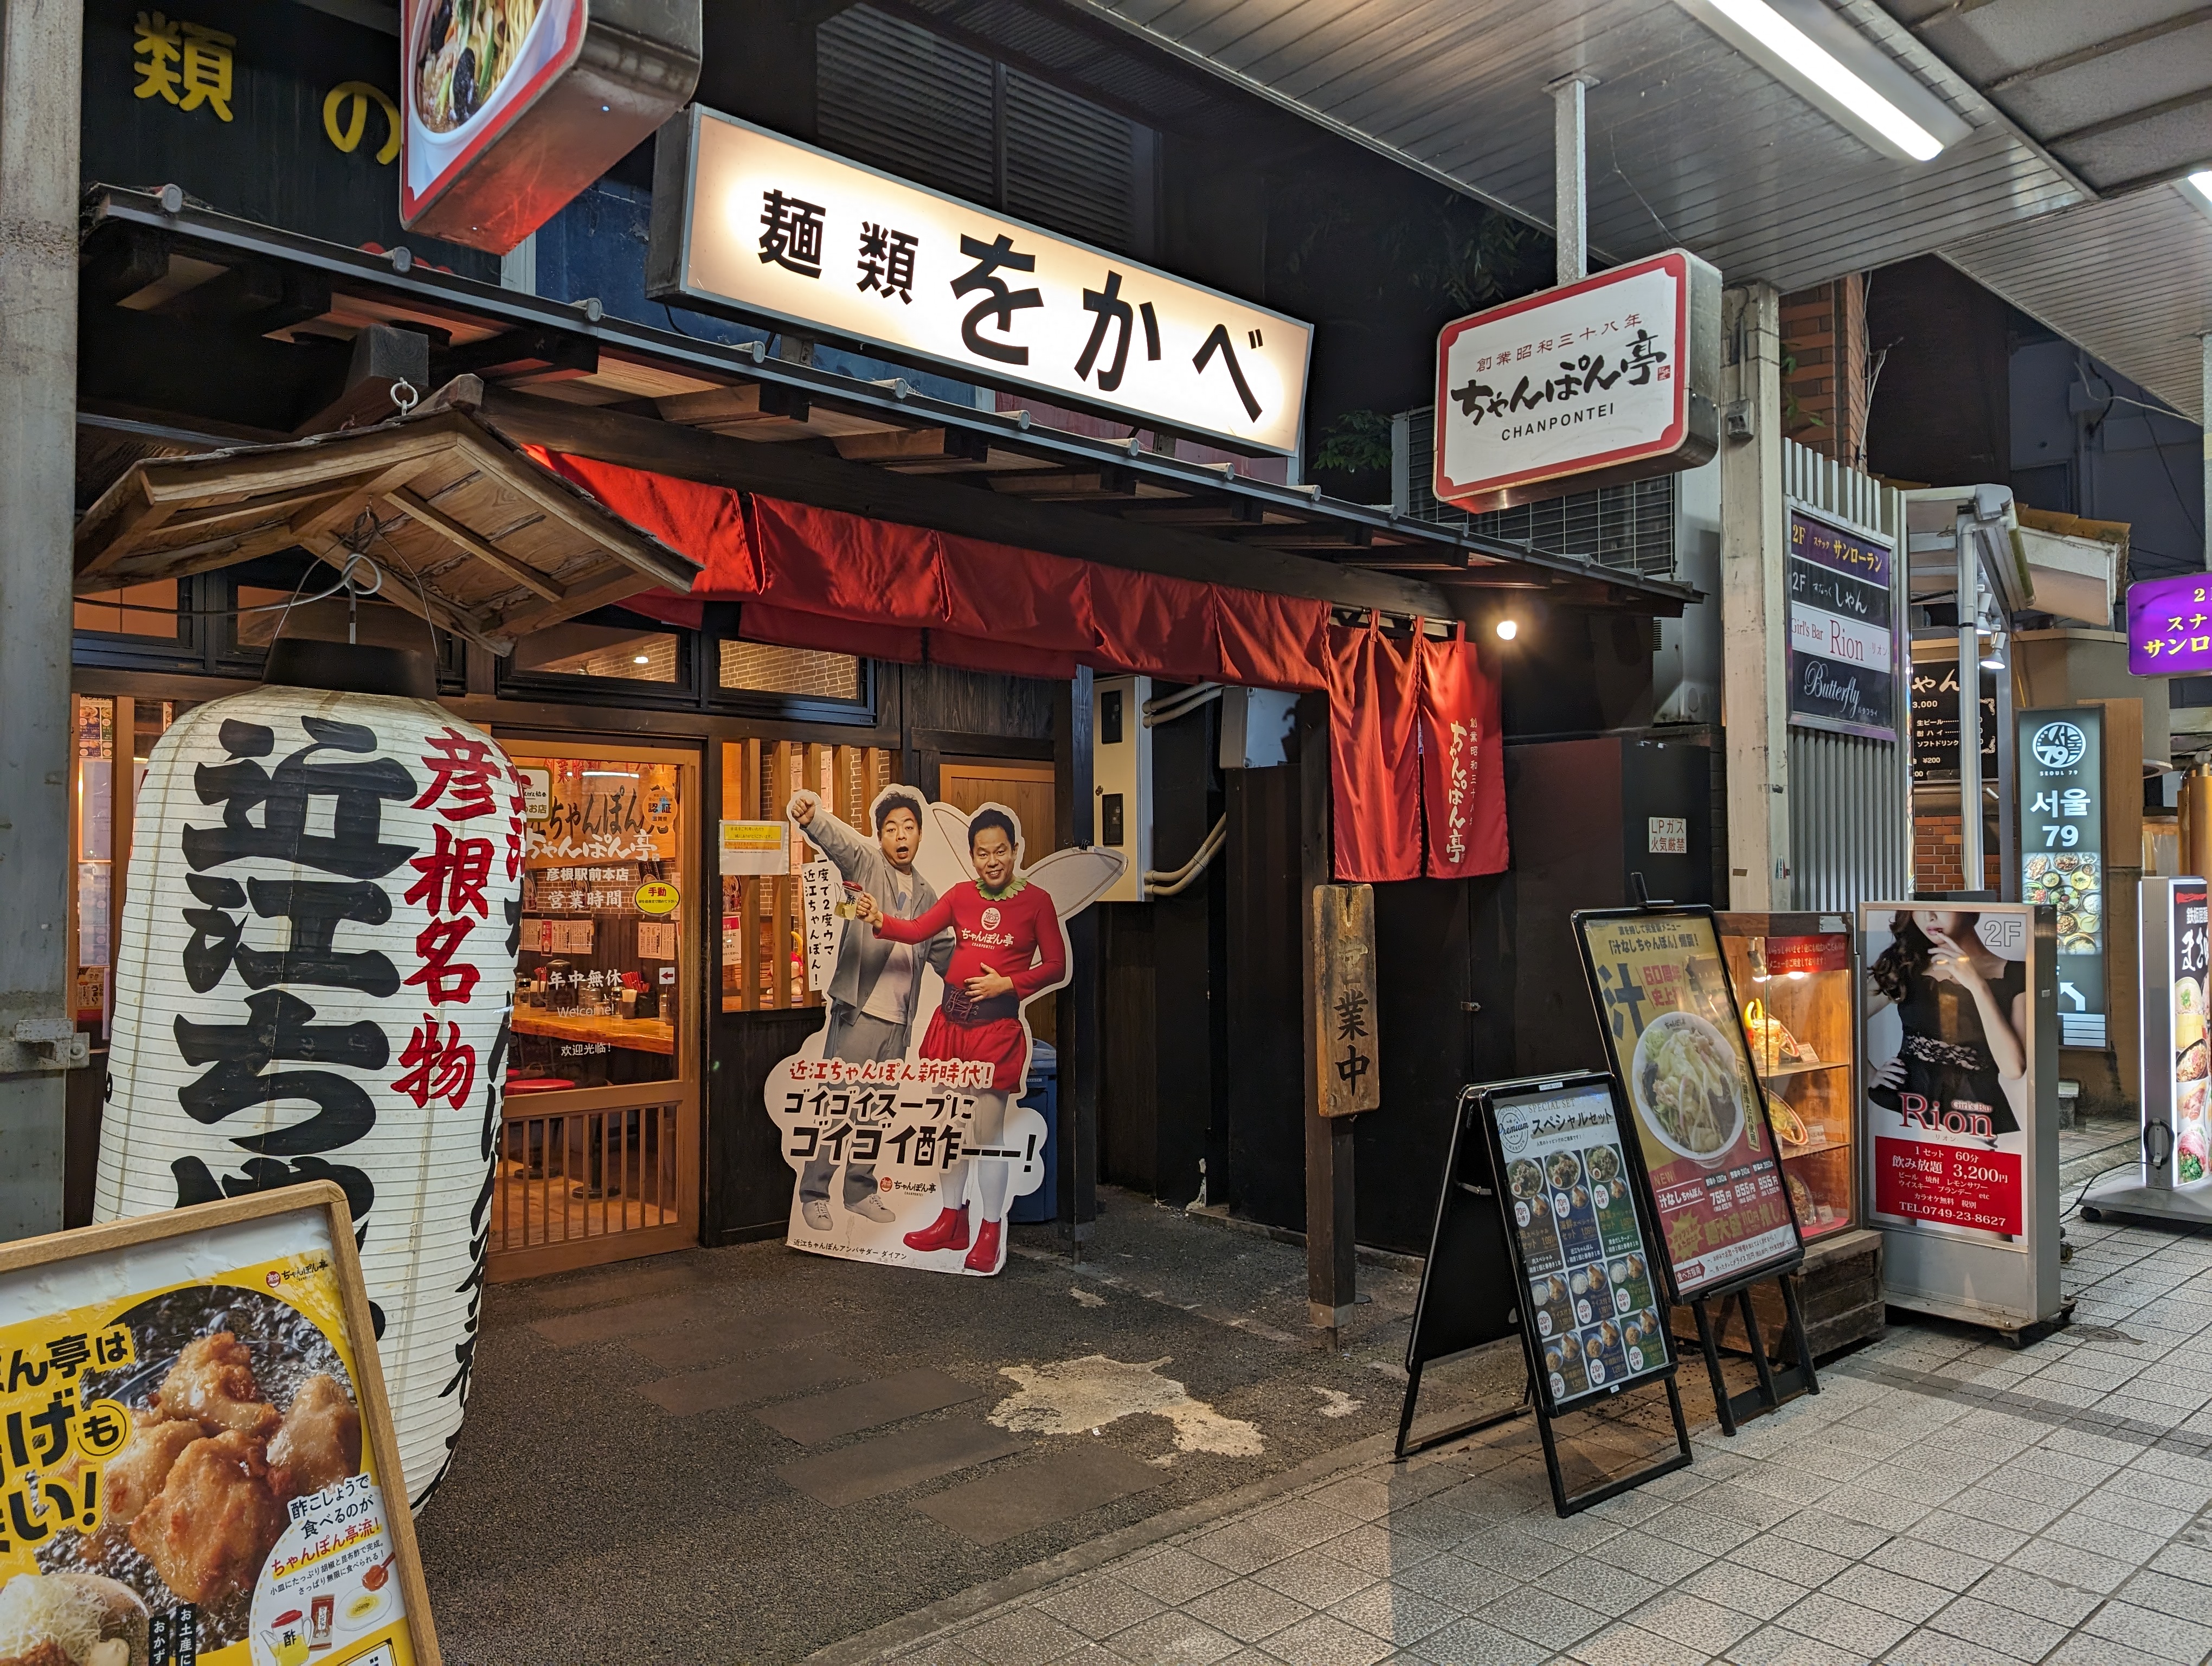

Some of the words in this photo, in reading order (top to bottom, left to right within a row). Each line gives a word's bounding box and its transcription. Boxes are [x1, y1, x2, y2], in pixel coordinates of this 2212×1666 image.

[1476, 313, 1642, 373] 創業昭和三十八年
[1451, 330, 1667, 425] ちゃんぽん亭
[1502, 402, 1614, 441] CHANPONTEI
[1792, 524, 1806, 544] 2F
[1814, 537, 1829, 550] スナック
[1834, 540, 1882, 573] サンローラン
[1792, 572, 1806, 592] 2F
[1835, 582, 1868, 614] しゃん
[2194, 587, 2212, 602] 2
[1791, 618, 1810, 637] Girl's
[1811, 624, 1824, 640] Bar
[1830, 620, 1864, 662] Rion
[2143, 636, 2210, 658] サンロ
[1804, 661, 1860, 717] Butterfly
[1446, 720, 1467, 863] ちゃんぽん亭
[648, 803, 672, 813] 認証
[2030, 789, 2091, 818] 서울
[1651, 819, 1684, 834] LPガス
[2042, 825, 2079, 847] 79
[1651, 837, 1684, 851] 火気厳禁
[546, 868, 629, 881] 彦根駅前本店
[548, 890, 622, 909] 営業時間
[648, 887, 667, 896] 手動
[846, 893, 856, 906] 酢
[390, 727, 502, 1111] 彦根名物
[961, 928, 1014, 946] ちゃんぽん亭
[1984, 921, 2022, 947] 2F
[548, 969, 623, 990] 年中無休
[557, 1004, 614, 1018] Welcome!
[1333, 935, 1371, 1097] 営業中
[784, 1089, 975, 1120] ゴイゴイスープに
[1528, 1101, 1560, 1113] SPECIAL
[1562, 1098, 1575, 1108] SET
[1952, 1101, 1975, 1111] Girl's
[1533, 1108, 1612, 1135] スペシャルセット
[1899, 1093, 1995, 1139] Rion
[1499, 1121, 1529, 1137] Premium
[1955, 1151, 1979, 1163] 60分
[1892, 1155, 1943, 1174] 飲み放題
[1953, 1163, 2008, 1184] 3,200円
[894, 1181, 936, 1194] ちゃんぽん亭
[1734, 1182, 1756, 1198] 855円
[1758, 1175, 1778, 1190] 955円
[1899, 1171, 1918, 1181] ビール
[1925, 1175, 1940, 1184] 焼酎
[1947, 1178, 1988, 1190] レモンサワー
[1899, 1180, 1931, 1189] ウイスキー
[1938, 1186, 1972, 1195] ブランデー
[1557, 1199, 1567, 1207] 70円
[1596, 1190, 1606, 1199] 70円
[1658, 1187, 1703, 1208] 汁なしちゃんぽん
[1709, 1190, 1732, 1205] 755円
[1914, 1193, 1954, 1206] カラオケ無料
[1962, 1200, 1977, 1209] 税別
[1516, 1208, 1527, 1216] 70円
[1899, 1201, 2006, 1226] TEL.0749-23-8627
[881, 1250, 908, 1260] ダイアン
[1677, 1266, 1701, 1281] 食べ方指南
[0, 1331, 128, 1394] ん亭は
[290, 1475, 369, 1520] 酢こしょうで
[301, 1494, 374, 1540] 食べるのが
[272, 1517, 380, 1577] ちゃんぽん亭流！
[270, 1540, 384, 1596] 小皿にたっぷり胡椒と昆布酢で完成。
[299, 1550, 384, 1595] さっぱり無限に食べられる！
[153, 1620, 166, 1665] おかず
[283, 1629, 297, 1648] 酢
